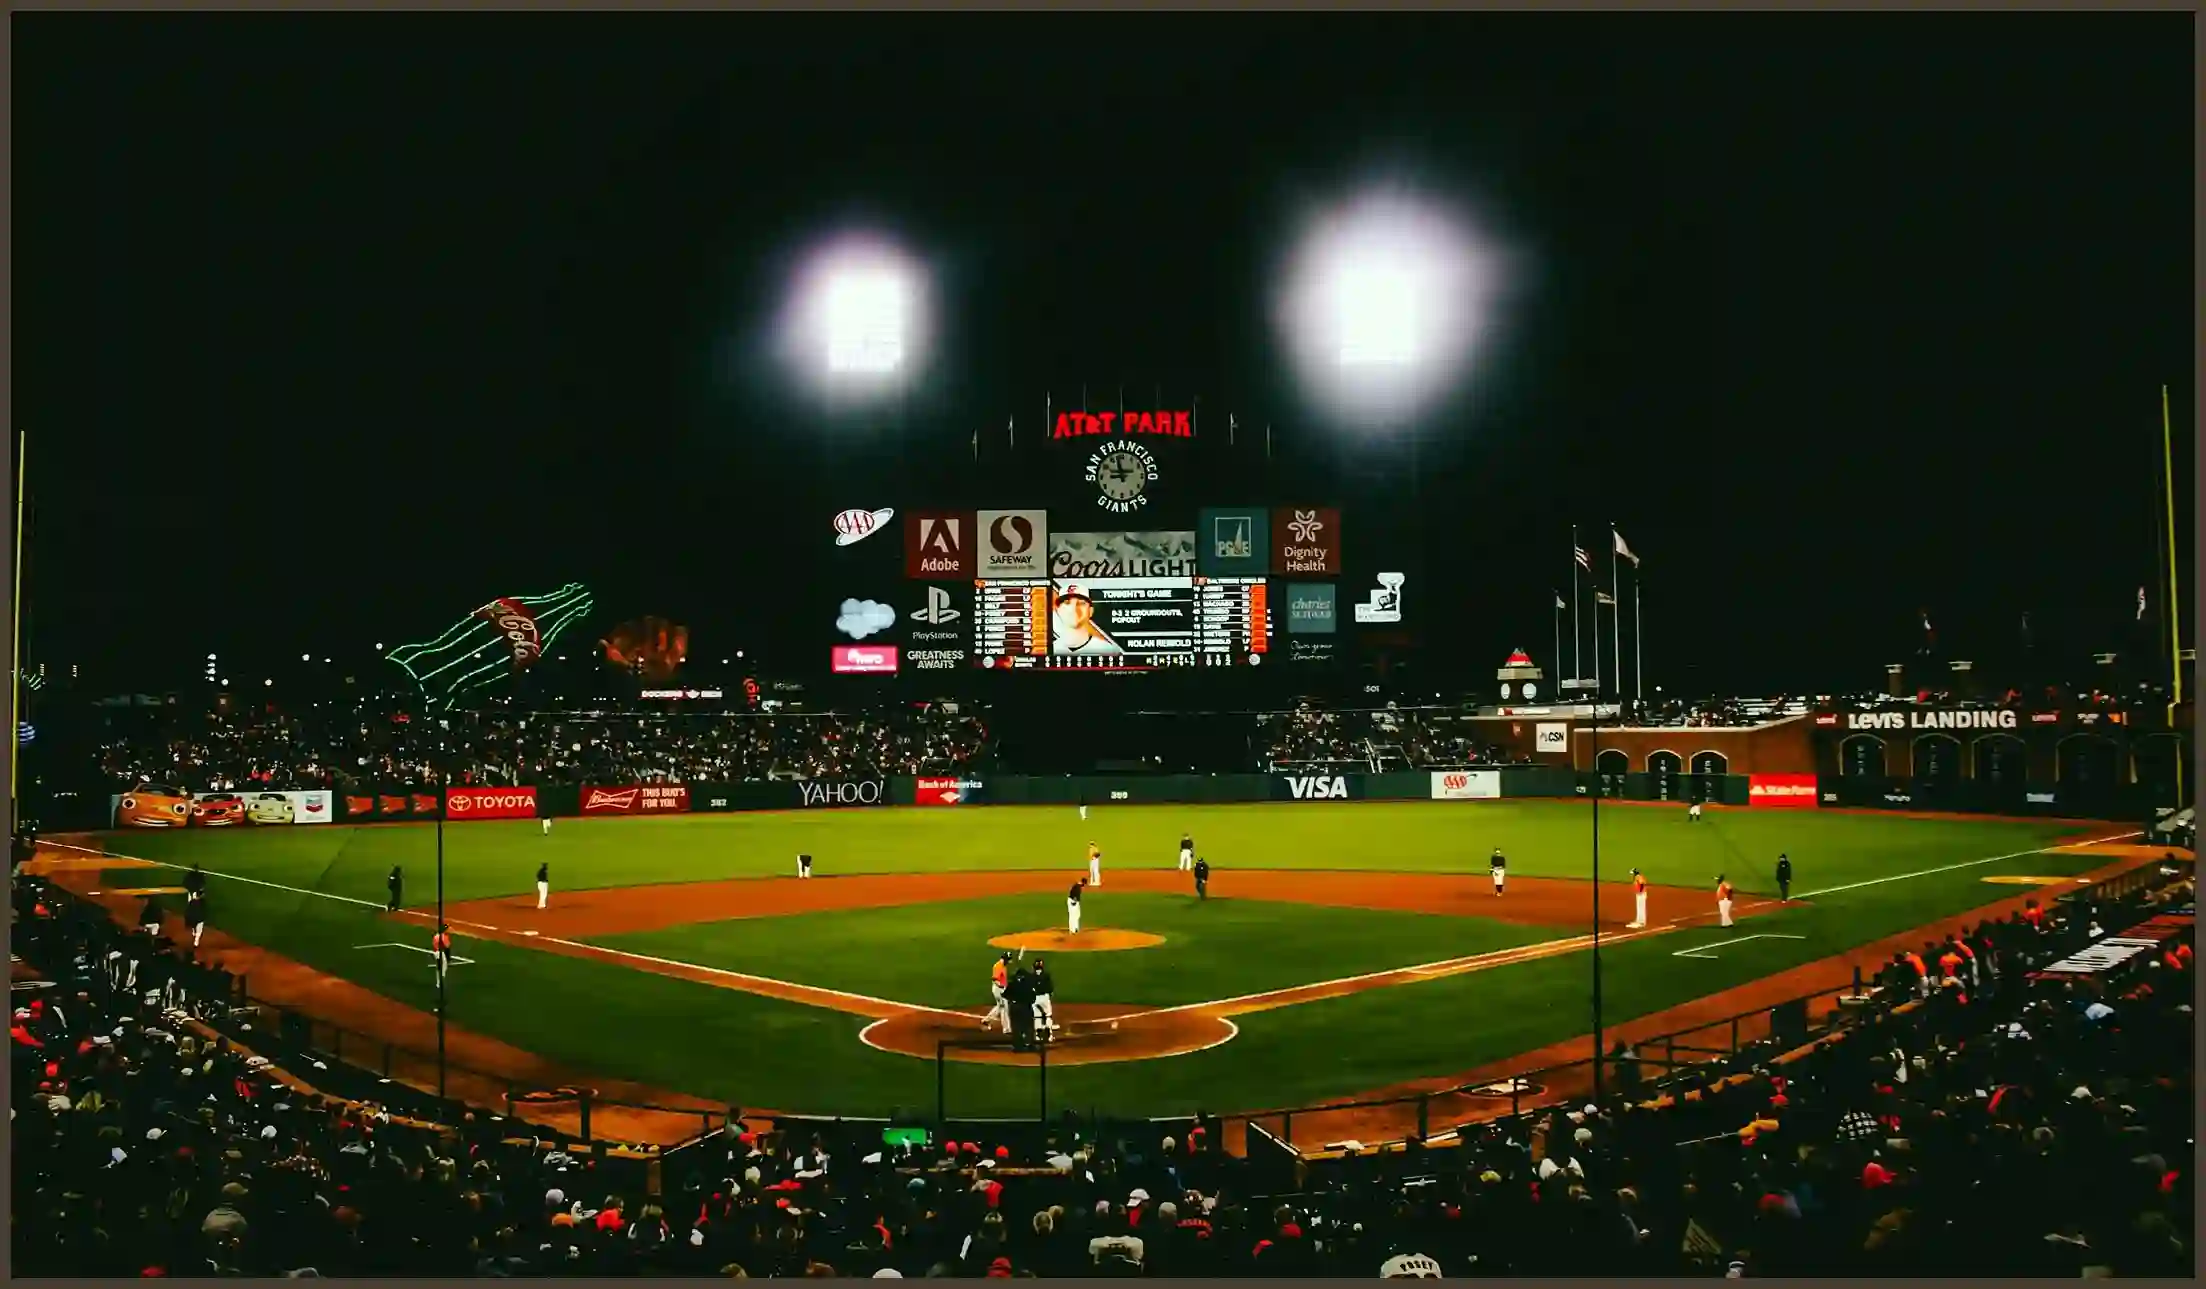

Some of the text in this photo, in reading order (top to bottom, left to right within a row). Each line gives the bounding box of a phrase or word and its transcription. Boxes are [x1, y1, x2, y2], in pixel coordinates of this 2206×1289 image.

[1053, 410, 1191, 439] AT&T PARK
[1085, 454, 1102, 481] SAN
[1100, 440, 1158, 480] FRANCISCO
[1098, 495, 1147, 513] GIANTS
[990, 555, 1032, 564] SAFEWAY
[1284, 546, 1328, 560] Dignity
[921, 558, 960, 572] Adobe
[1050, 551, 1197, 577] Coors LIGHT
[1287, 560, 1326, 572] Health
[1147, 590, 1172, 598] GAME
[913, 632, 958, 640] PlayStation
[907, 650, 964, 660] GREATNESS
[917, 660, 955, 669] AWAITS
[1911, 711, 2016, 729] LANDING
[1549, 732, 1564, 741] CSN
[642, 788, 660, 797] THIS
[798, 779, 884, 806] YAHOO!
[1284, 776, 1348, 798] VISA
[473, 795, 536, 809] TOYOTA
[642, 799, 658, 808] FOR
